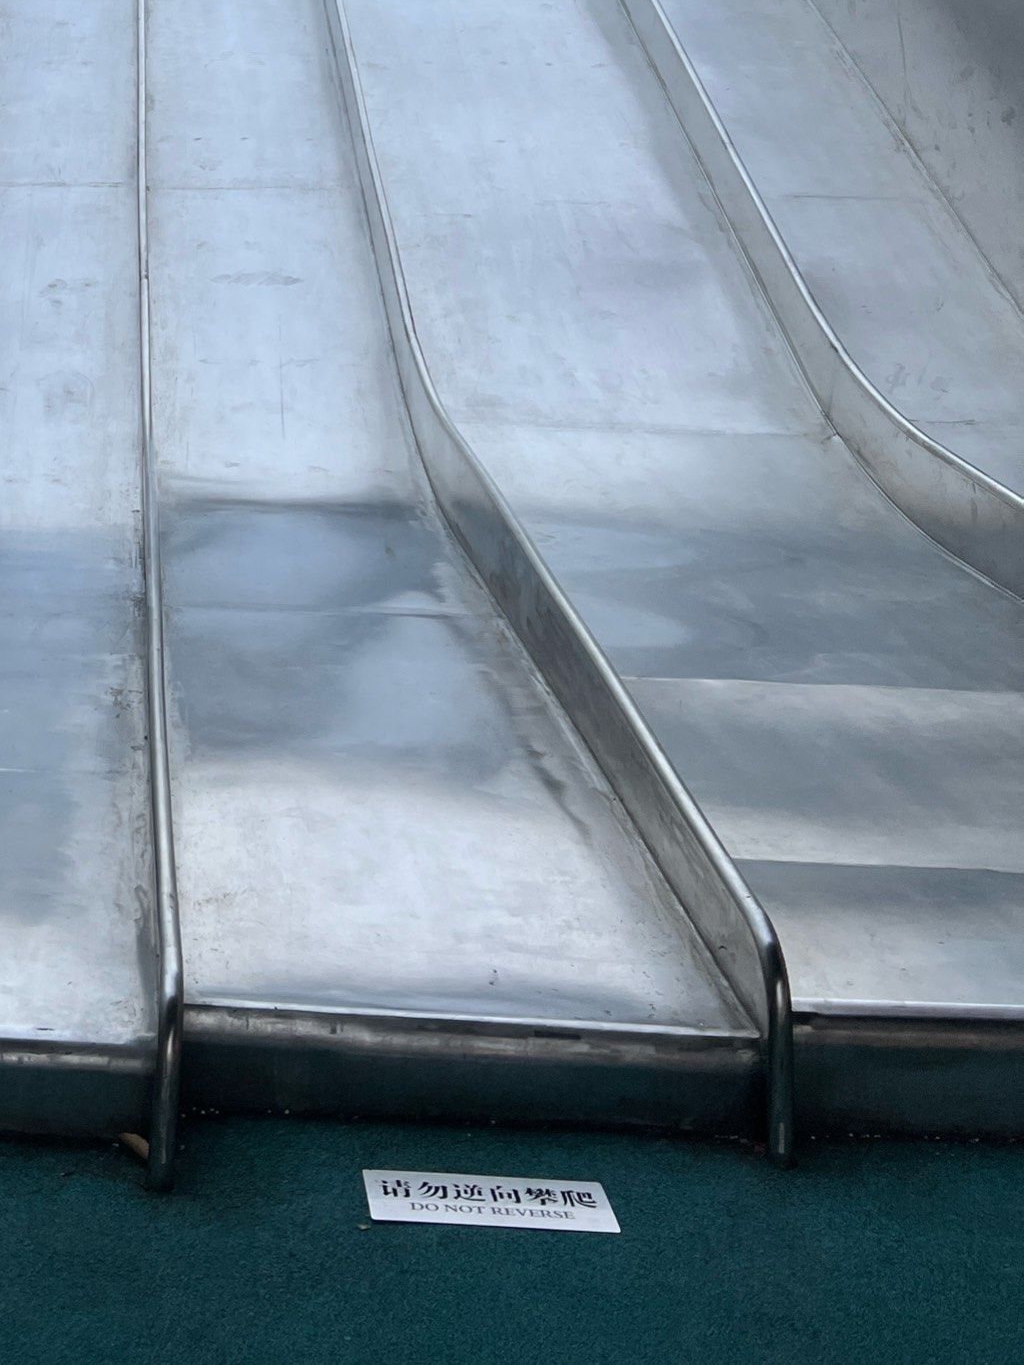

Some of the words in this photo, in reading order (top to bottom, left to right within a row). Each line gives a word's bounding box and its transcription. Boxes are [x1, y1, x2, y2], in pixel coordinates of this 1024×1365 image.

[380, 1179, 598, 1209] 请勿逆向攀爬
[409, 1202, 440, 1212] DO
[444, 1204, 487, 1215] NOT
[491, 1207, 576, 1220] REVERSE
